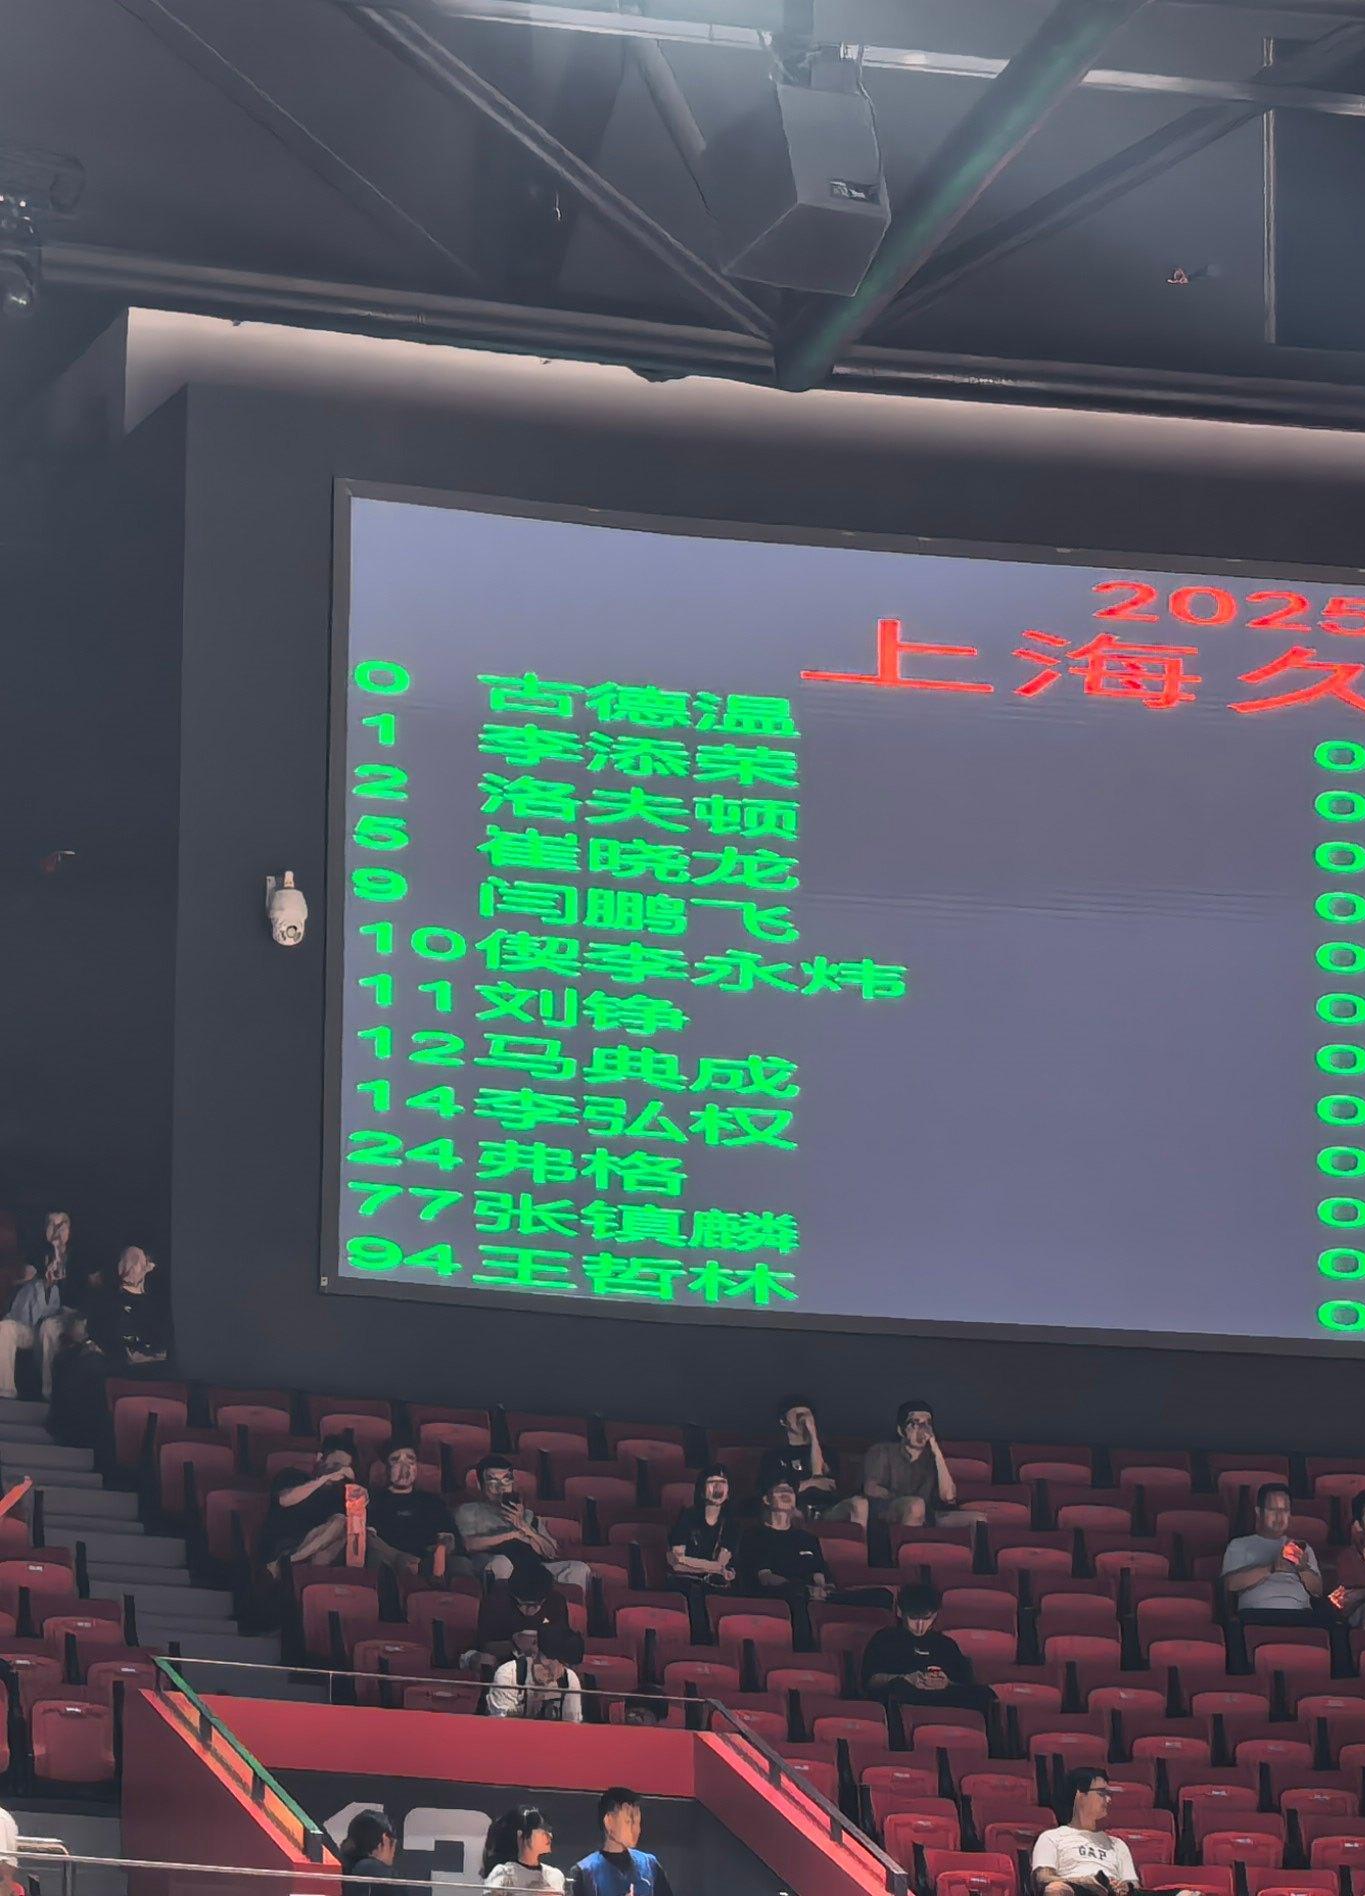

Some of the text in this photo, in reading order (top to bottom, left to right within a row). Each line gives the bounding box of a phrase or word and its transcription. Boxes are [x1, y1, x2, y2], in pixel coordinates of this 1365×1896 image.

[353, 659, 801, 739] 0 古德温
[361, 712, 800, 788] 1 李添荣
[352, 763, 800, 841] 2 洛夫顿
[352, 814, 799, 891] 5 崔晓龙
[350, 866, 799, 943] 9 闫鹏飞
[359, 919, 469, 963] 10
[359, 972, 690, 1036] 11 刘铮
[357, 1024, 800, 1099] 12 马典成
[356, 1077, 798, 1151] 14 李弘权
[346, 1129, 688, 1198] 24 弗格
[347, 1180, 464, 1222] 77
[345, 1234, 798, 1306] 94 王哲林
[1078, 1845, 1107, 1860] GAP
